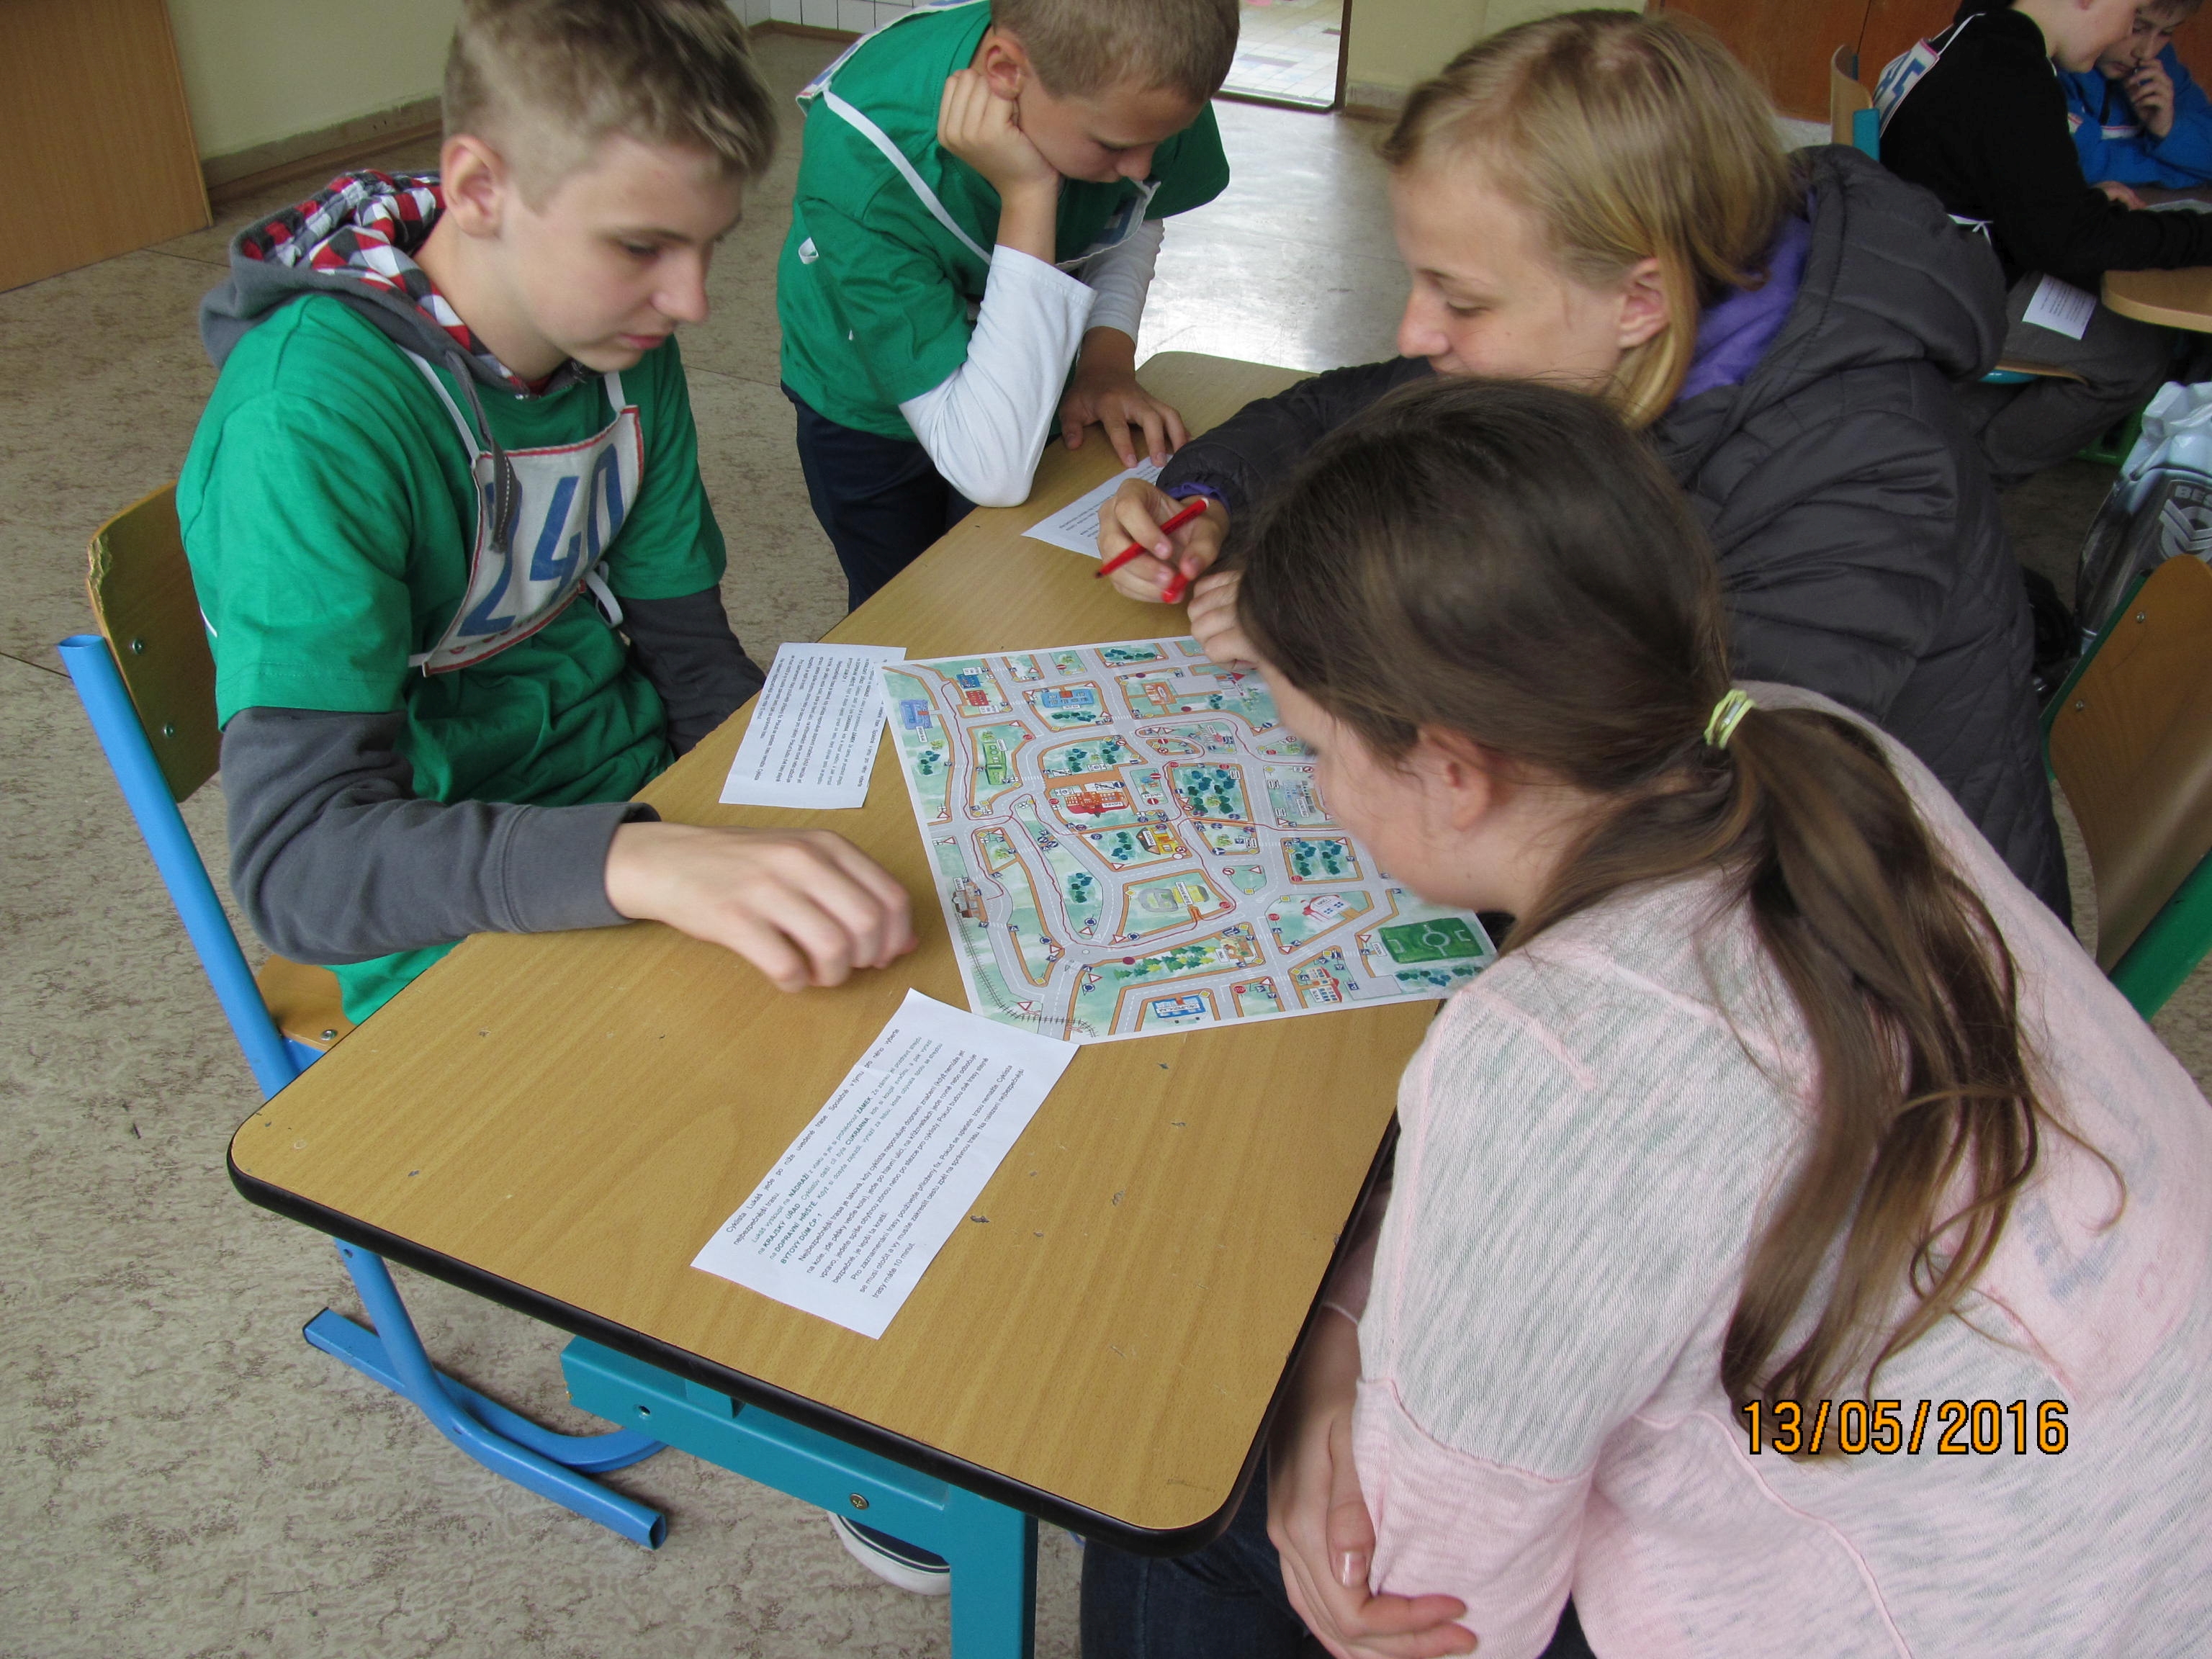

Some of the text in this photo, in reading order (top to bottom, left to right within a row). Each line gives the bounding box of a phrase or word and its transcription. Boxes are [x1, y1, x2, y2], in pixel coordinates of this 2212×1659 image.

[457, 444, 624, 637] 240
[762, 1220, 786, 1248] KRAJSKÝ
[773, 1222, 800, 1253] DOPRAVNÍ
[780, 1240, 801, 1264] BYTOVÝ
